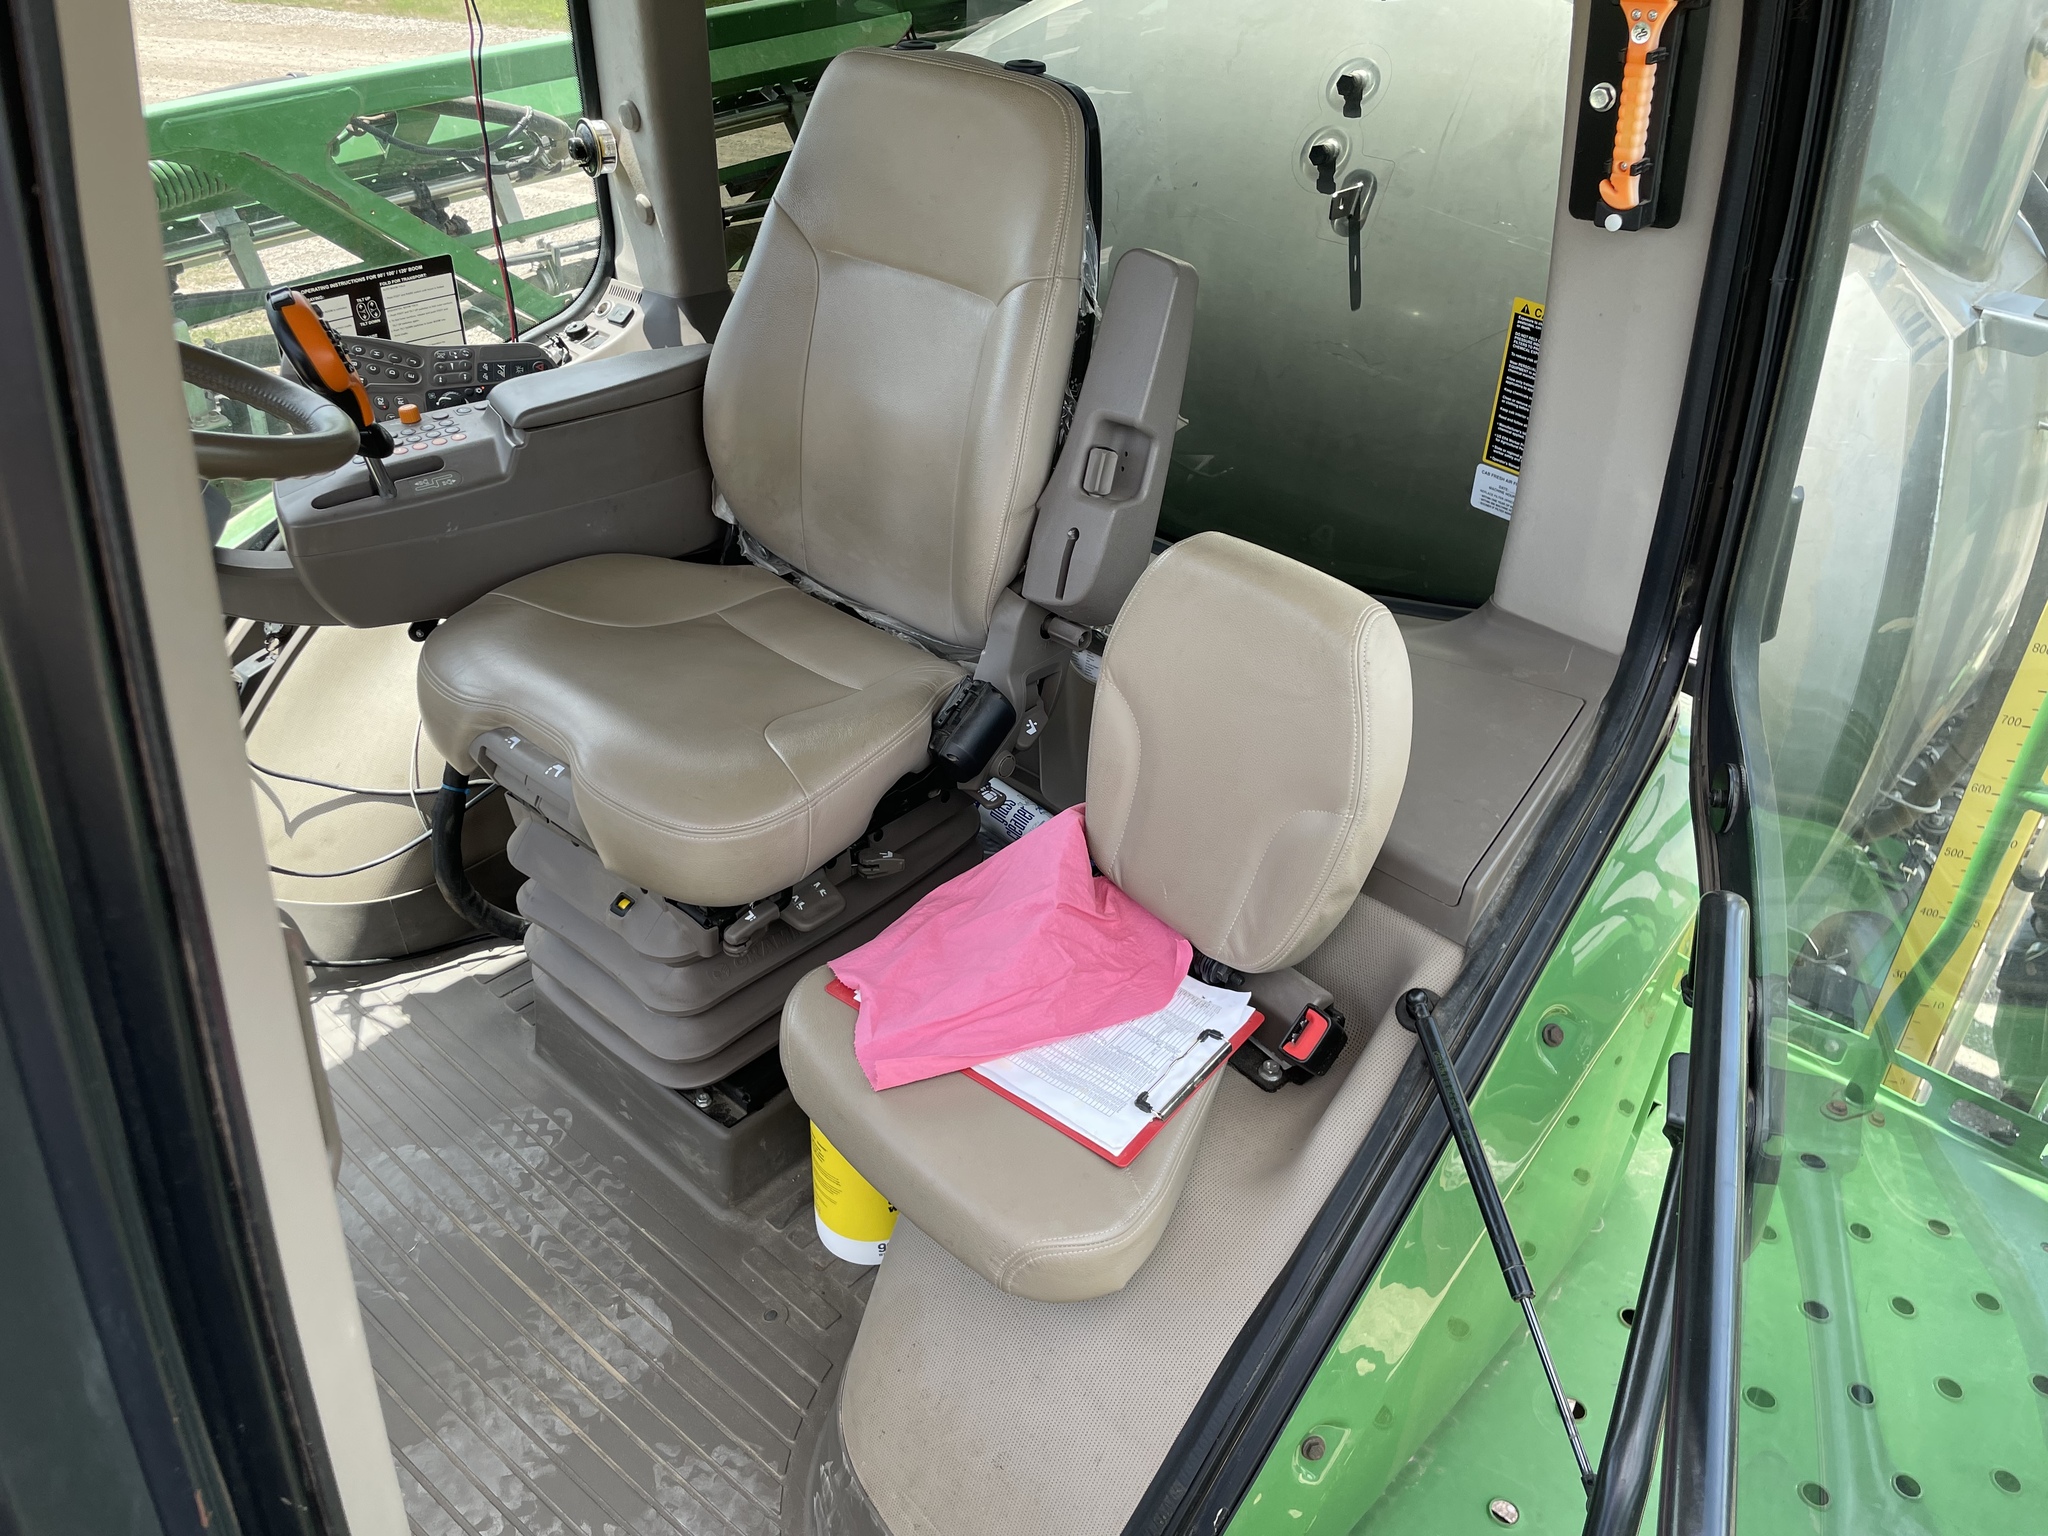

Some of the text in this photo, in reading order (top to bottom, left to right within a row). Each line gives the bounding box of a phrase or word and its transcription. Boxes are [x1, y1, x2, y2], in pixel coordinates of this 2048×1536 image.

[301, 284, 329, 295] OPERATING
[330, 276, 366, 289] INSTRUCTIONS
[408, 264, 423, 272] BOOM
[1514, 336, 1533, 345] PRESSURE
[1513, 344, 1530, 353] CHEMICAL
[1509, 364, 1528, 373] EQUIPMENT
[377, 397, 384, 405] R2
[1491, 473, 1505, 481] FRESH
[1489, 486, 1505, 494] MACHINE
[2032, 643, 2048, 655] 80
[2001, 714, 2022, 727] 700
[1971, 783, 1991, 795] 600
[990, 799, 1016, 826] glass
[1006, 806, 1035, 840] cleaner
[1944, 848, 1964, 859] 500
[1920, 908, 1939, 918] 400
[1893, 969, 1907, 979] 30
[1932, 1001, 1944, 1009] 10
